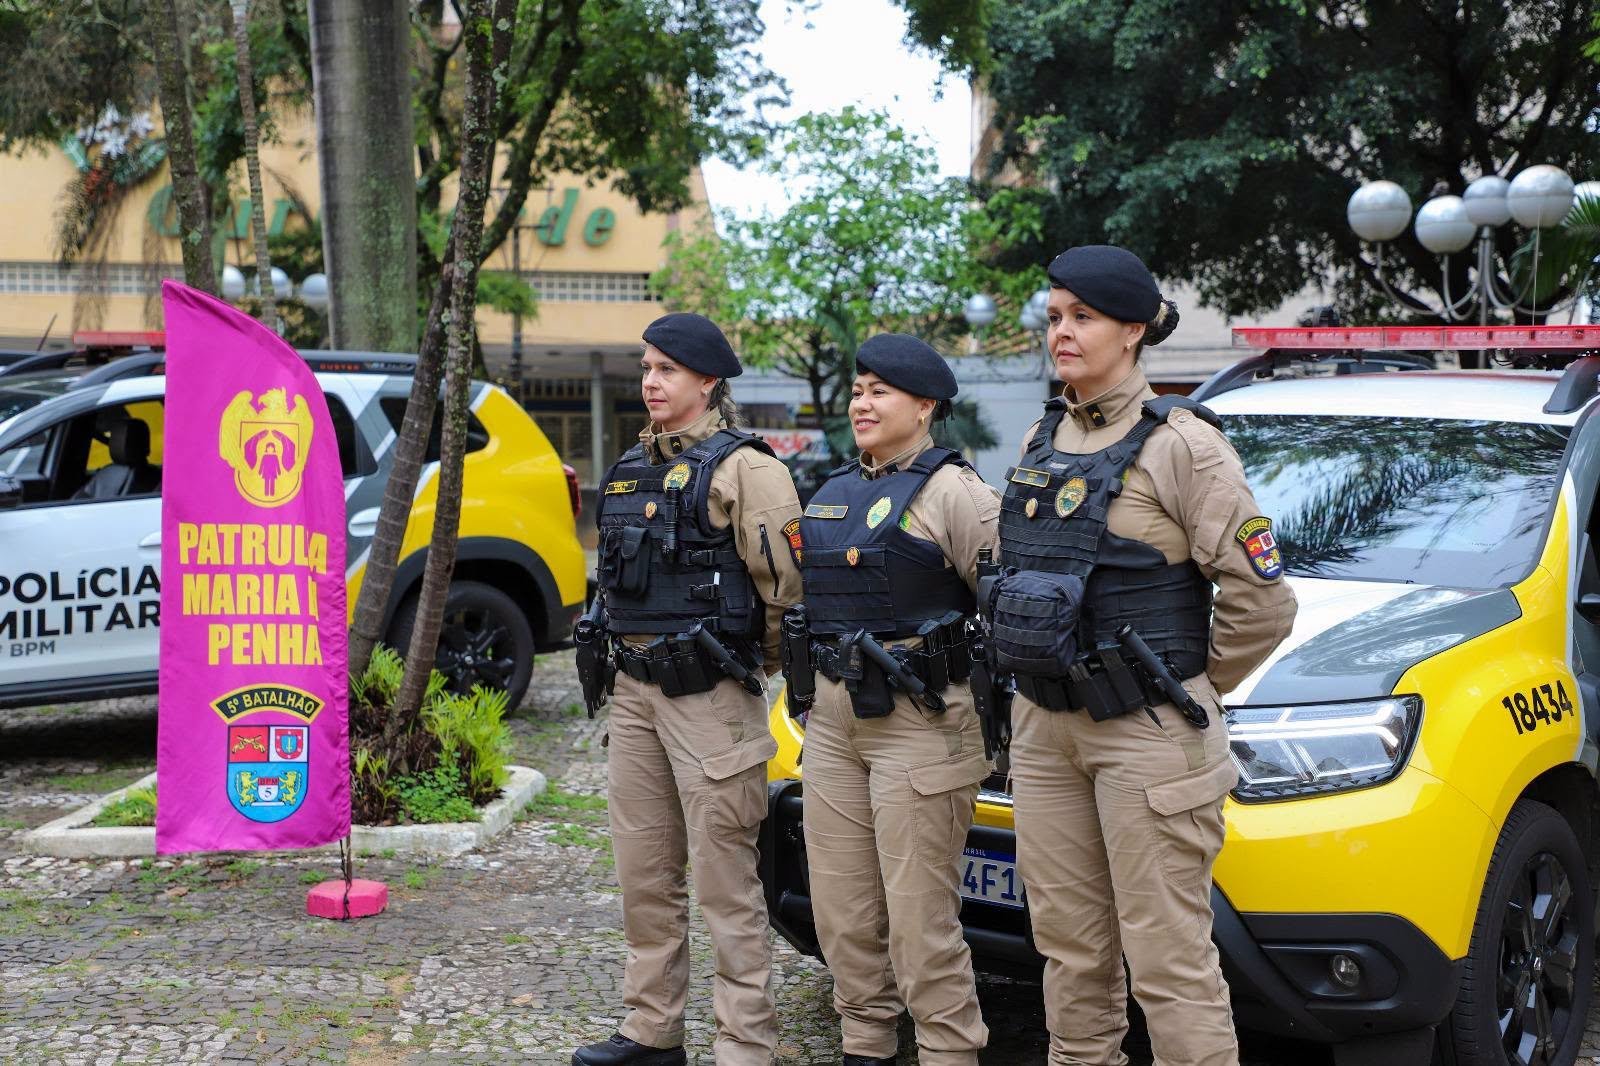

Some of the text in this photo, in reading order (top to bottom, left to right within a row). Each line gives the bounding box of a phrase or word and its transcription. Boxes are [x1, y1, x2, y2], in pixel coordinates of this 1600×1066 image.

[178, 522, 328, 576] PATRULA
[182, 573, 301, 616] MARIA
[10, 640, 56, 658] BPM
[208, 623, 323, 666] PENHA
[1502, 680, 1575, 736] 18434
[264, 787, 272, 798] 5
[963, 847, 986, 857] RASIL
[963, 860, 1025, 903] 4F1
